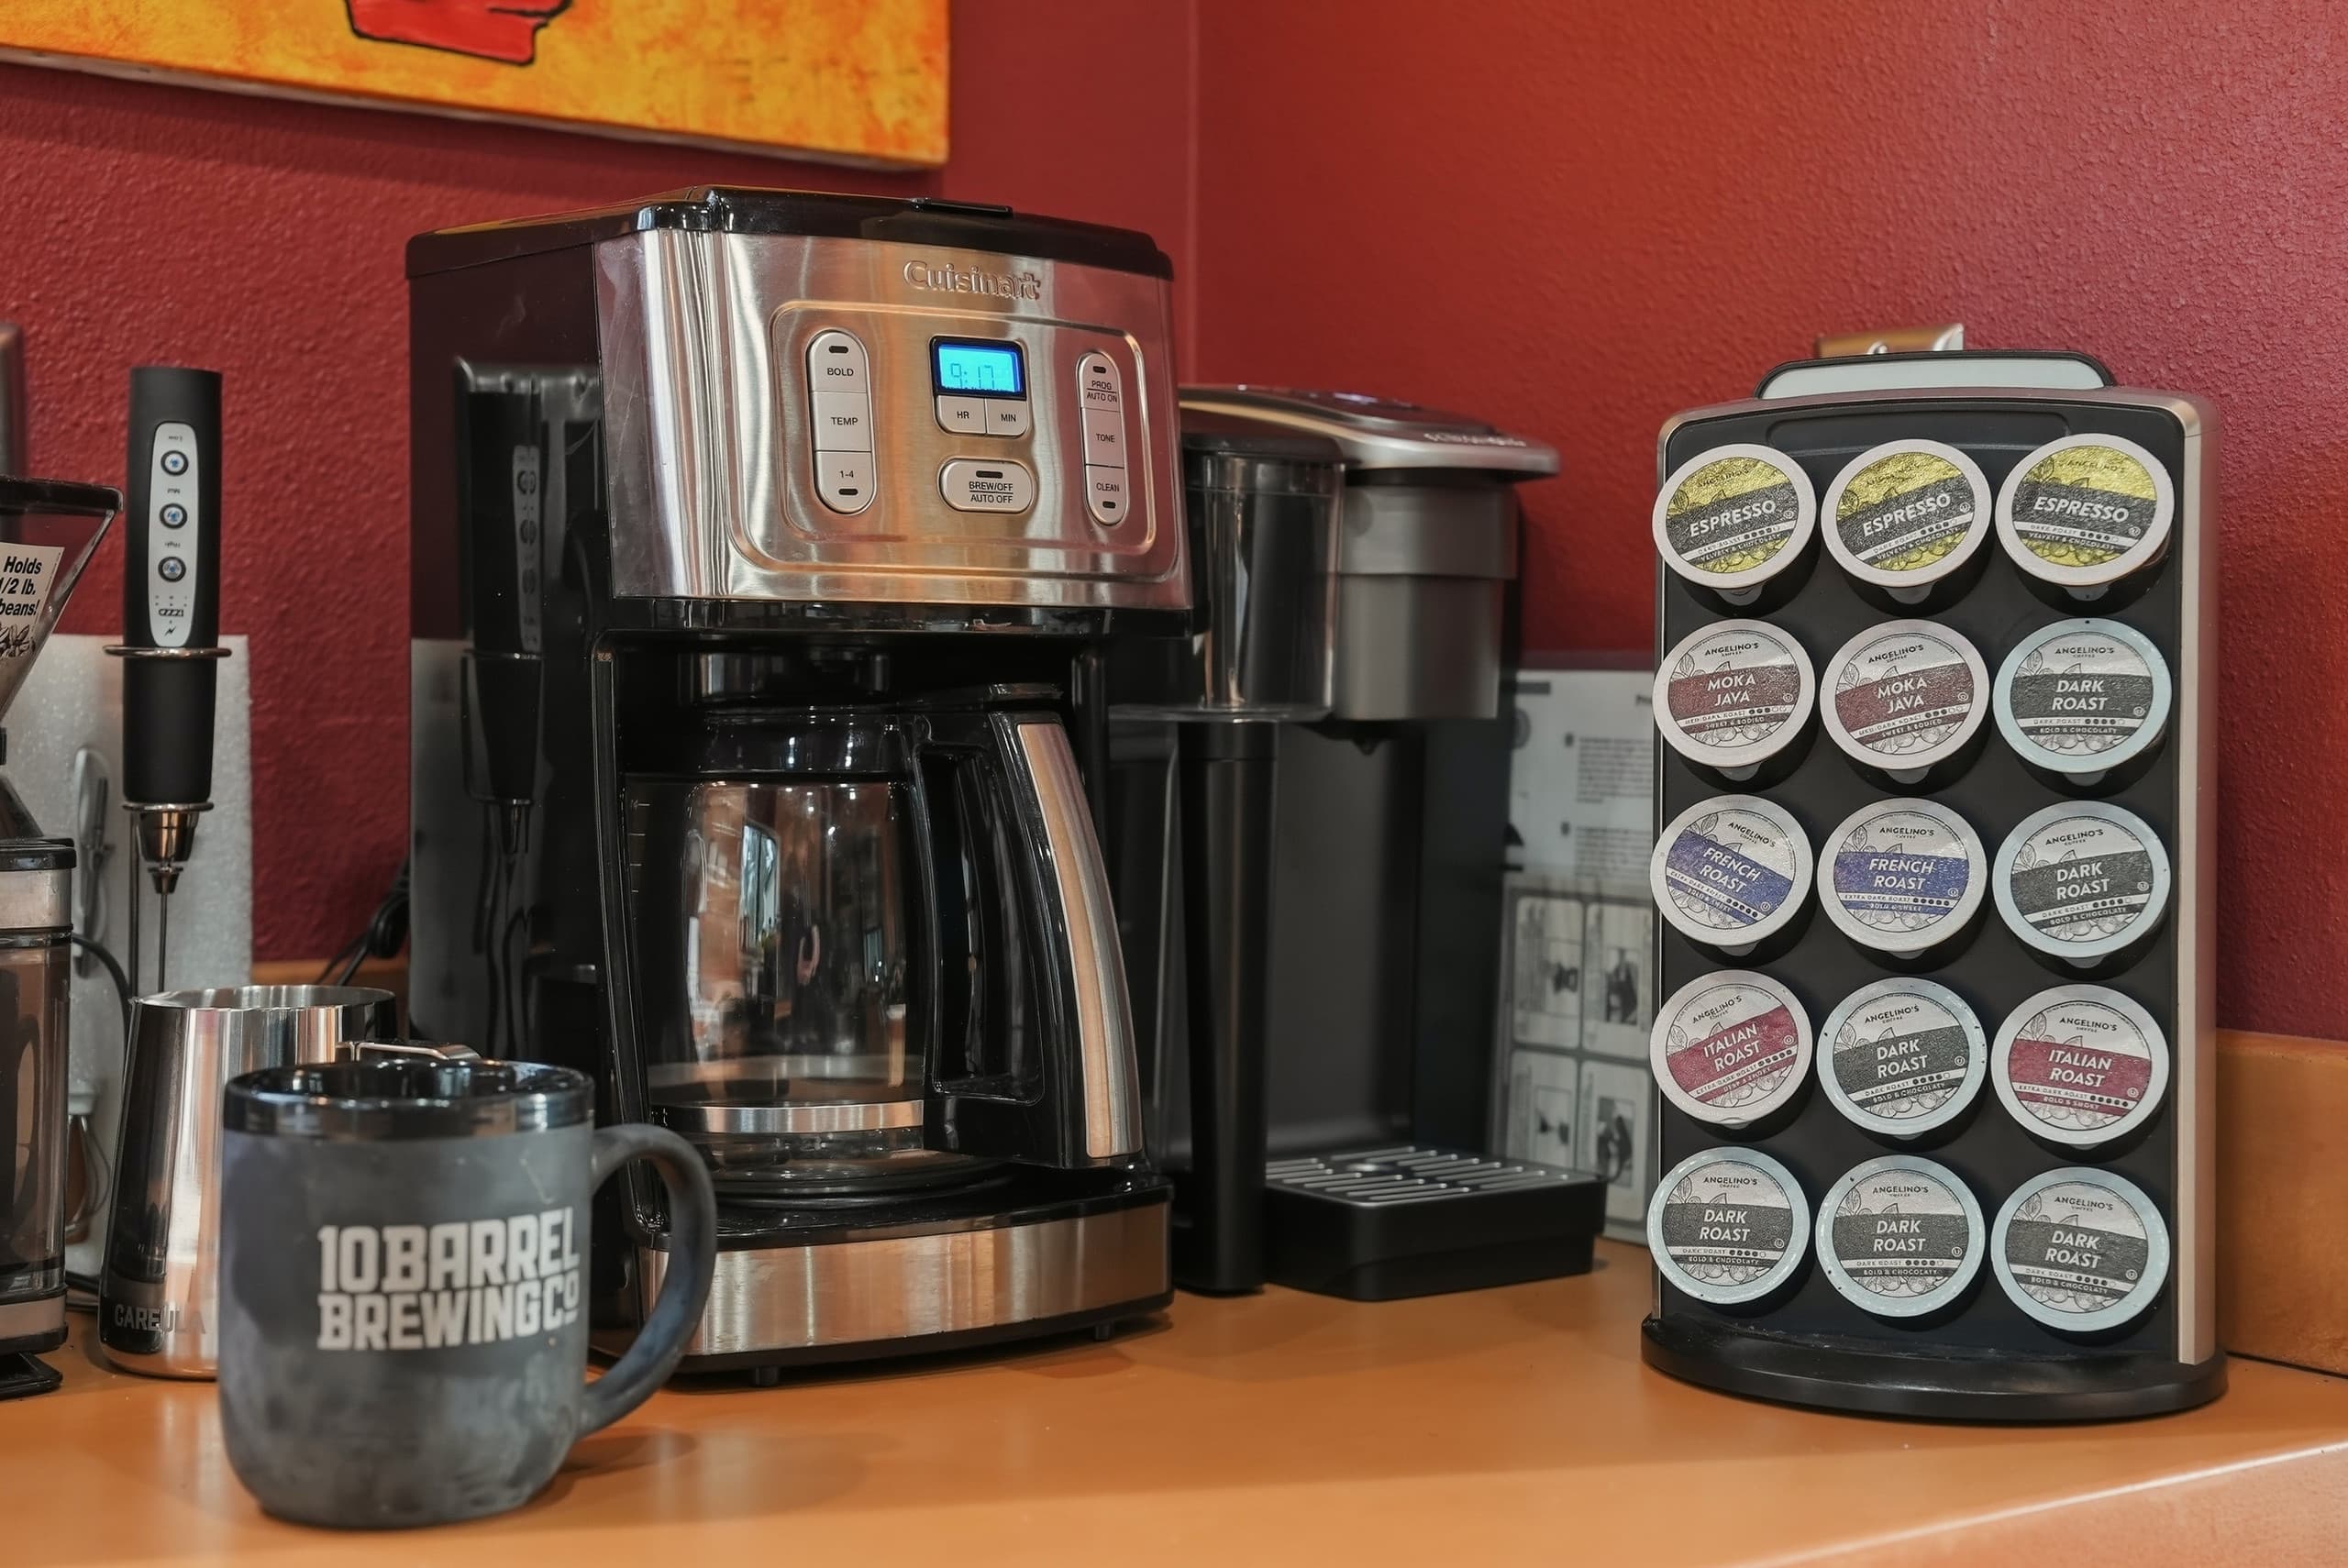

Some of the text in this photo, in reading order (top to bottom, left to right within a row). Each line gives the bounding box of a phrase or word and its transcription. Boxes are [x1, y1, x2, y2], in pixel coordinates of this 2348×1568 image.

[903, 259, 1040, 301] Cuisinart
[826, 368, 854, 377] BOLD
[950, 363, 995, 390] 9:17
[1091, 381, 1113, 390] PROG
[1086, 392, 1118, 403] AUTO ON
[831, 416, 858, 426] TEMP
[957, 411, 969, 419] HR
[1001, 414, 1016, 422] MIN
[1096, 433, 1115, 443] TONE
[839, 470, 855, 479] 1-4
[969, 480, 1013, 492] BREW/OFF
[1096, 482, 1120, 492] CLEAN
[970, 493, 1013, 504] AUTO OFF
[1690, 501, 1776, 536] ESPRESSO
[1863, 493, 1951, 536] ESPRESSO
[2033, 497, 2129, 523] ESPRESSO
[4, 556, 42, 575] Holds
[21, 578, 36, 595] lb.
[0, 598, 40, 616] beans!
[1704, 643, 1758, 656] ANGELINO'S
[1868, 645, 1924, 663] ANGELINO'S
[1707, 674, 1756, 690] MOKA
[1878, 678, 1927, 699] MOKA
[2056, 680, 2105, 692] DARK
[1714, 690, 1750, 706] JAVA
[1888, 695, 1924, 713] JAVA
[2052, 698, 2108, 710] ROAST
[1728, 823, 1776, 847] ANGELINO'S
[1880, 827, 1934, 836] ANGELINO'S
[2045, 829, 2103, 845] ANGELINO'S
[1703, 847, 1761, 881] FRENCH
[1869, 858, 1933, 873] FRENCH
[2057, 862, 2102, 882] DARK
[1700, 865, 1746, 893] ROAST
[1874, 876, 1926, 889] ROAST
[2057, 878, 2110, 900] ROAST
[1692, 996, 1742, 1023] ANGELINO'S
[1865, 1005, 1919, 1023] ANGELINO'S
[2059, 1017, 2118, 1031] ANGELINO'S
[1703, 1023, 1757, 1057] ITALIAN
[1714, 1041, 1761, 1072] ROAST
[1877, 1039, 1920, 1060] DARK
[1877, 1055, 1928, 1078] ROAST
[2049, 1049, 2111, 1070] ITALIAN
[2049, 1068, 2105, 1087] ROAST
[2054, 1196, 2113, 1210] ANGELINO'S
[1704, 1209, 1748, 1223] DARK
[1700, 1227, 1750, 1242] ROAST
[1877, 1220, 1922, 1233] DARK
[1873, 1238, 1926, 1252] ROAST
[2052, 1231, 2100, 1249] DARK
[317, 1207, 580, 1293] 10 BARREL
[2045, 1248, 2101, 1268] ROAST
[317, 1279, 541, 1351] BREWING
